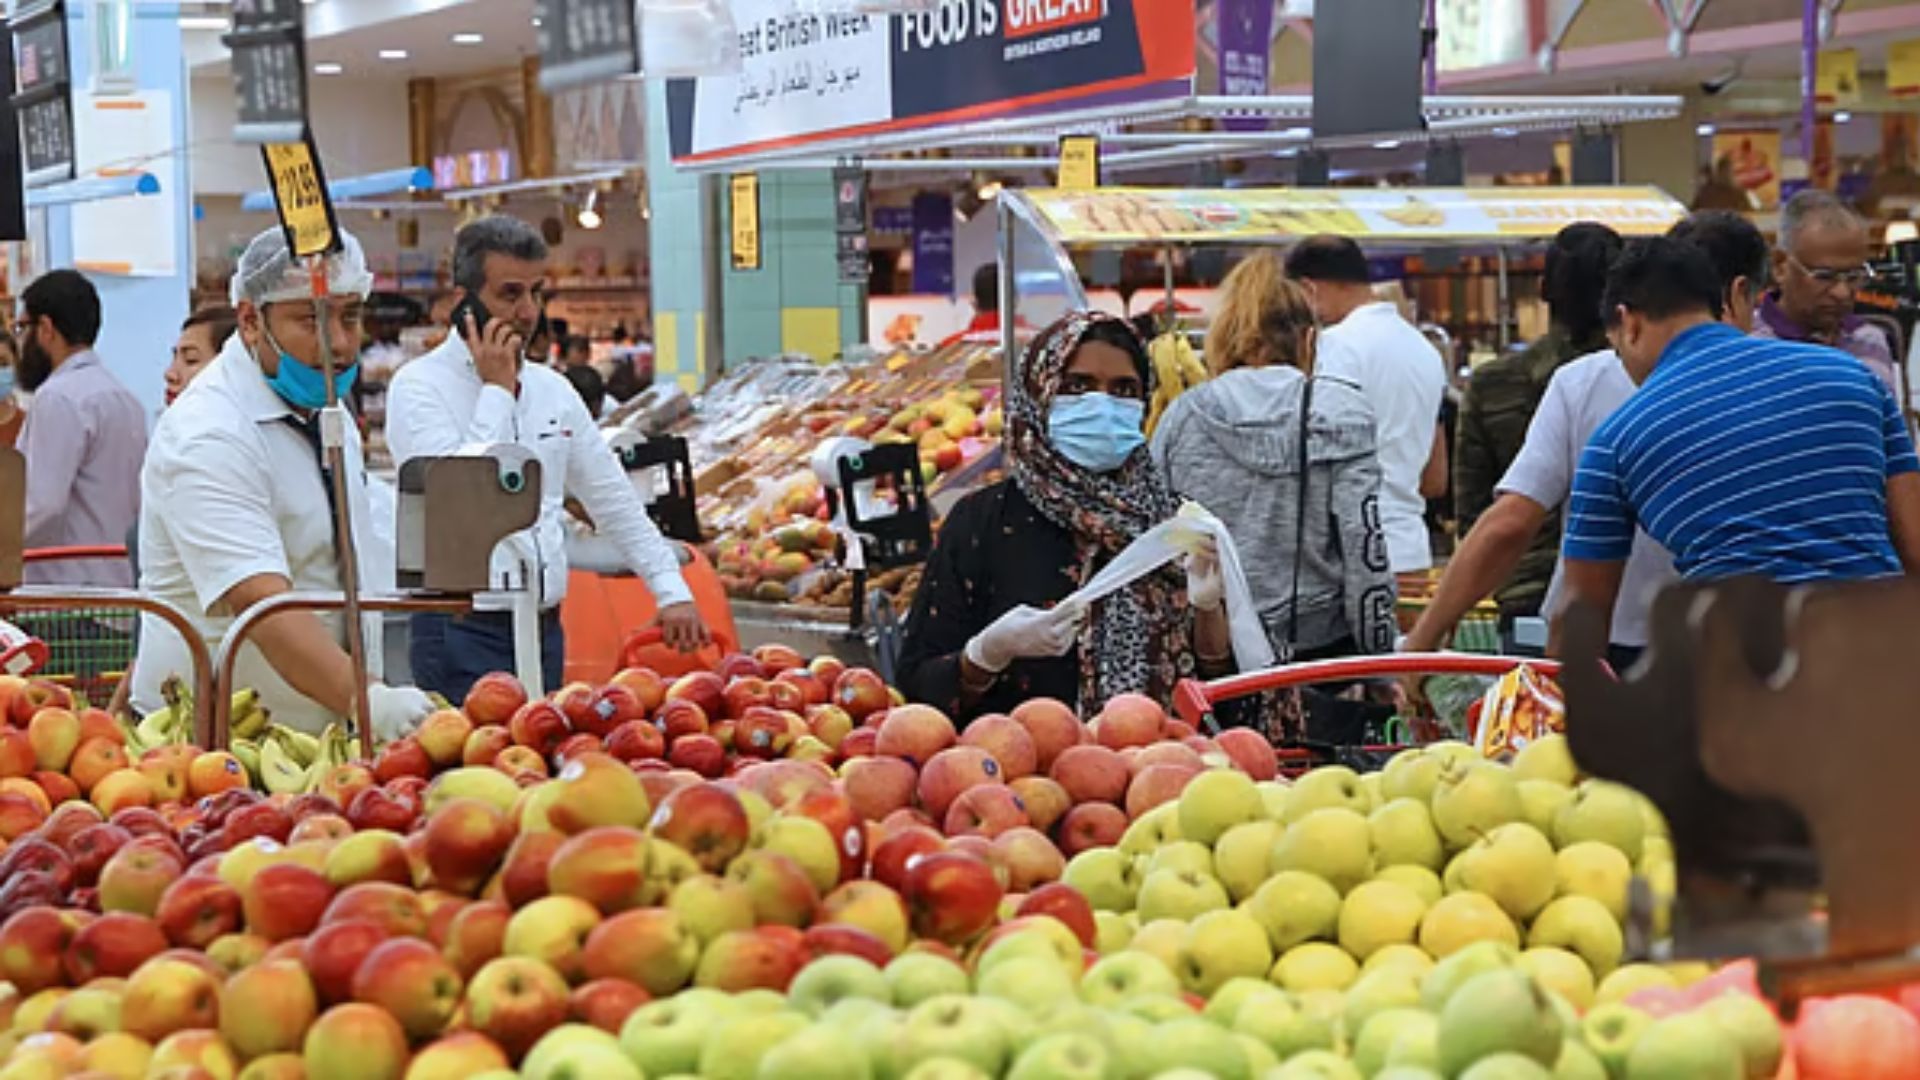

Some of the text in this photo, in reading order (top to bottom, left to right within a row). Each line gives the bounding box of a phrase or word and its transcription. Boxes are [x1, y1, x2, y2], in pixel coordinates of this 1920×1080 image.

[738, 13, 872, 58] eat British Week
[902, 0, 969, 51] FOOD
[974, 0, 998, 36] IS
